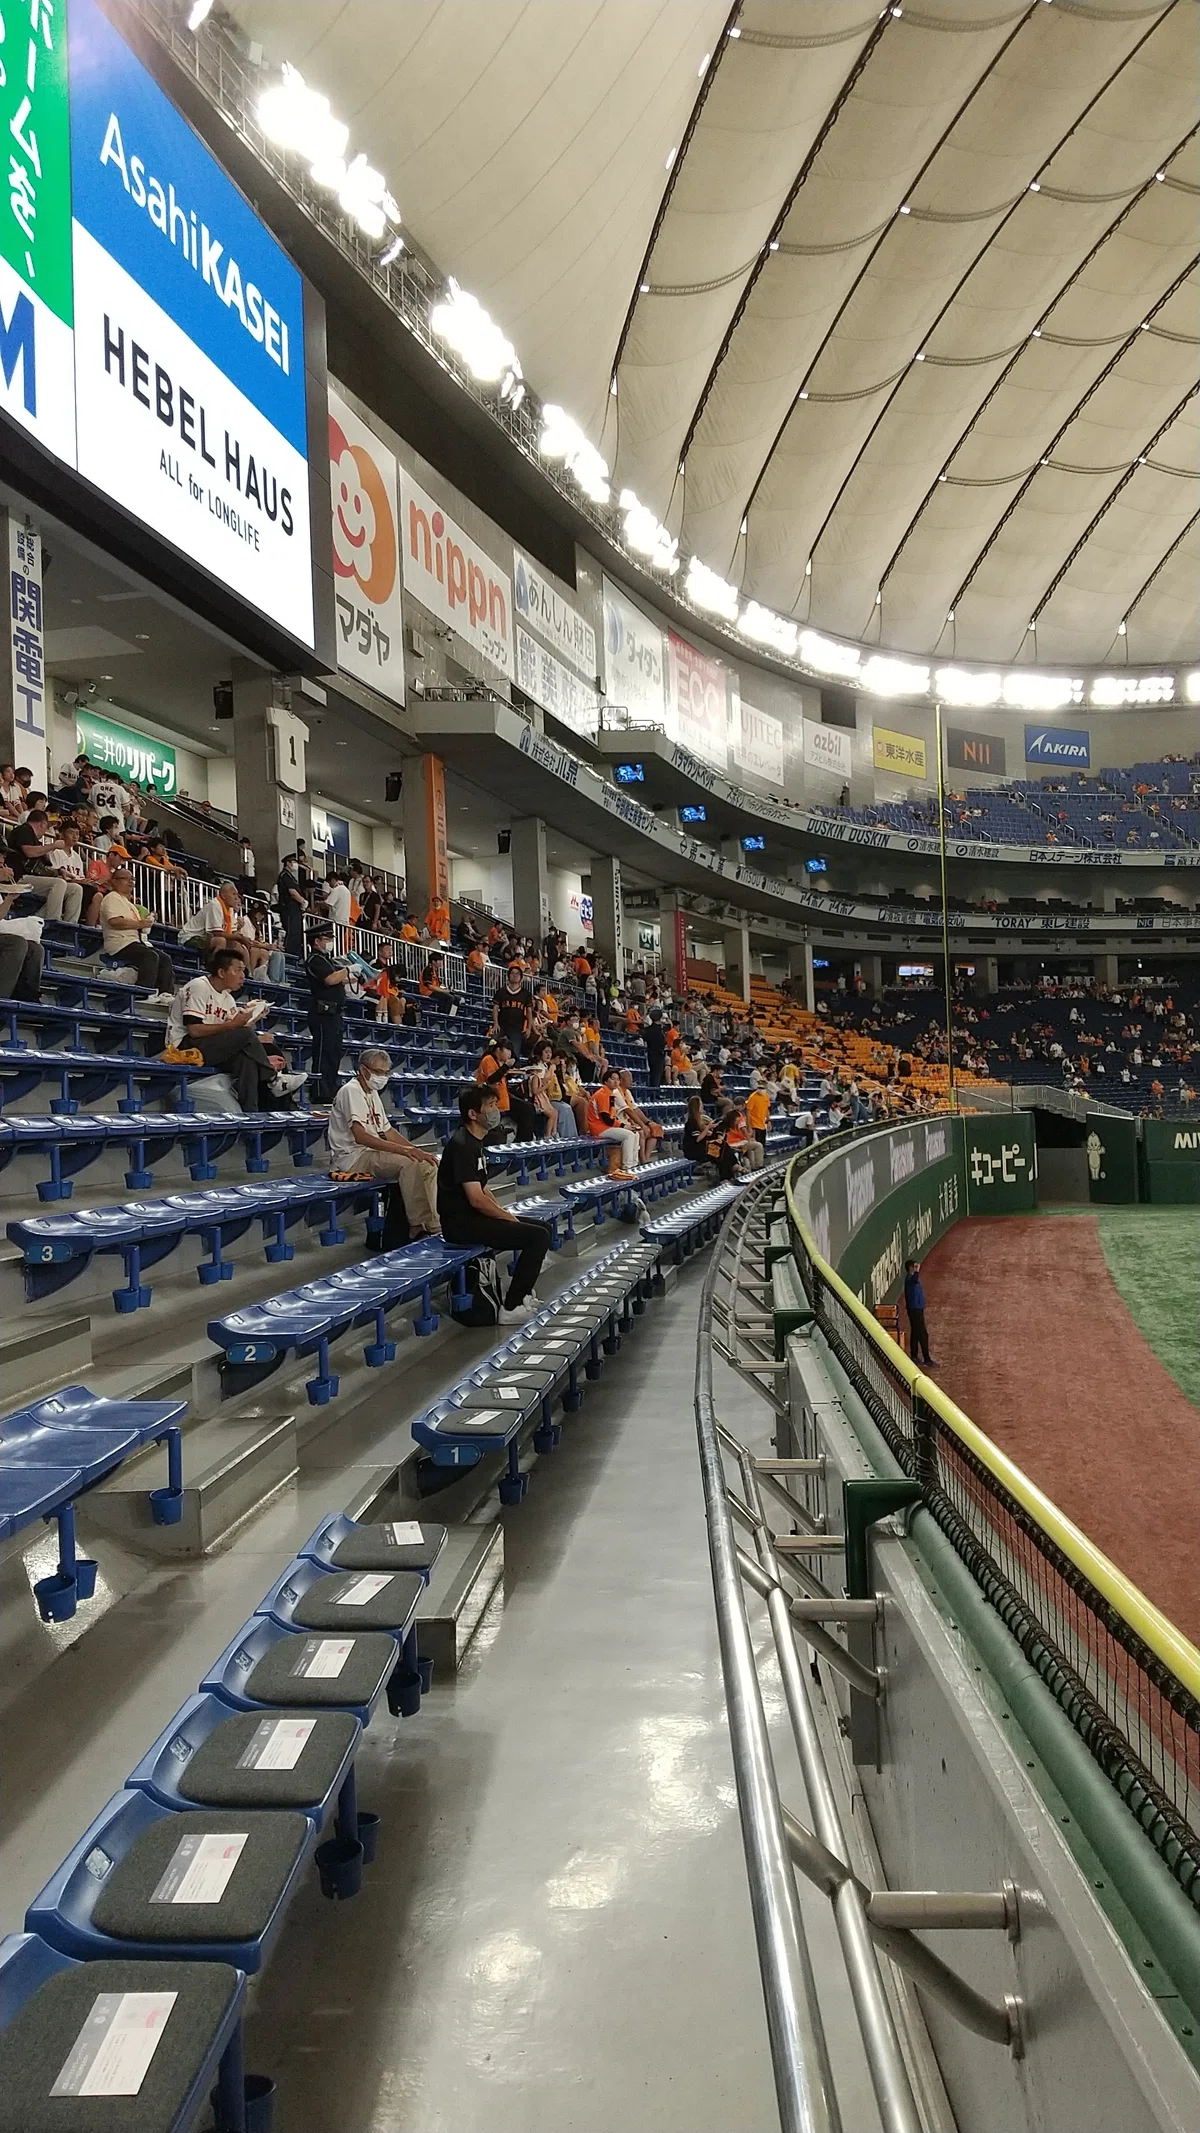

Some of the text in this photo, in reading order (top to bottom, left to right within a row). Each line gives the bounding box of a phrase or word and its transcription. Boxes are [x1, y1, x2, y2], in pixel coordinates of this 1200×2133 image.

[100, 112, 290, 377] AsahiKASEI
[103, 312, 294, 537] HEBEL HAUS
[159, 448, 261, 552] ALL for LONGLIFE
[409, 499, 508, 640] nippn
[528, 573, 595, 664] あんしん財団
[11, 570, 45, 738] 関電工
[92, 732, 175, 792] 三井のリパーク
[813, 732, 842, 757] azbil
[885, 742, 924, 767] 東洋水産
[1043, 743, 1088, 758] AKIRA
[97, 793, 116, 808] 64
[41, 1245, 53, 1262] 3
[244, 1345, 256, 1362] 2
[450, 1446, 460, 1464] 1
